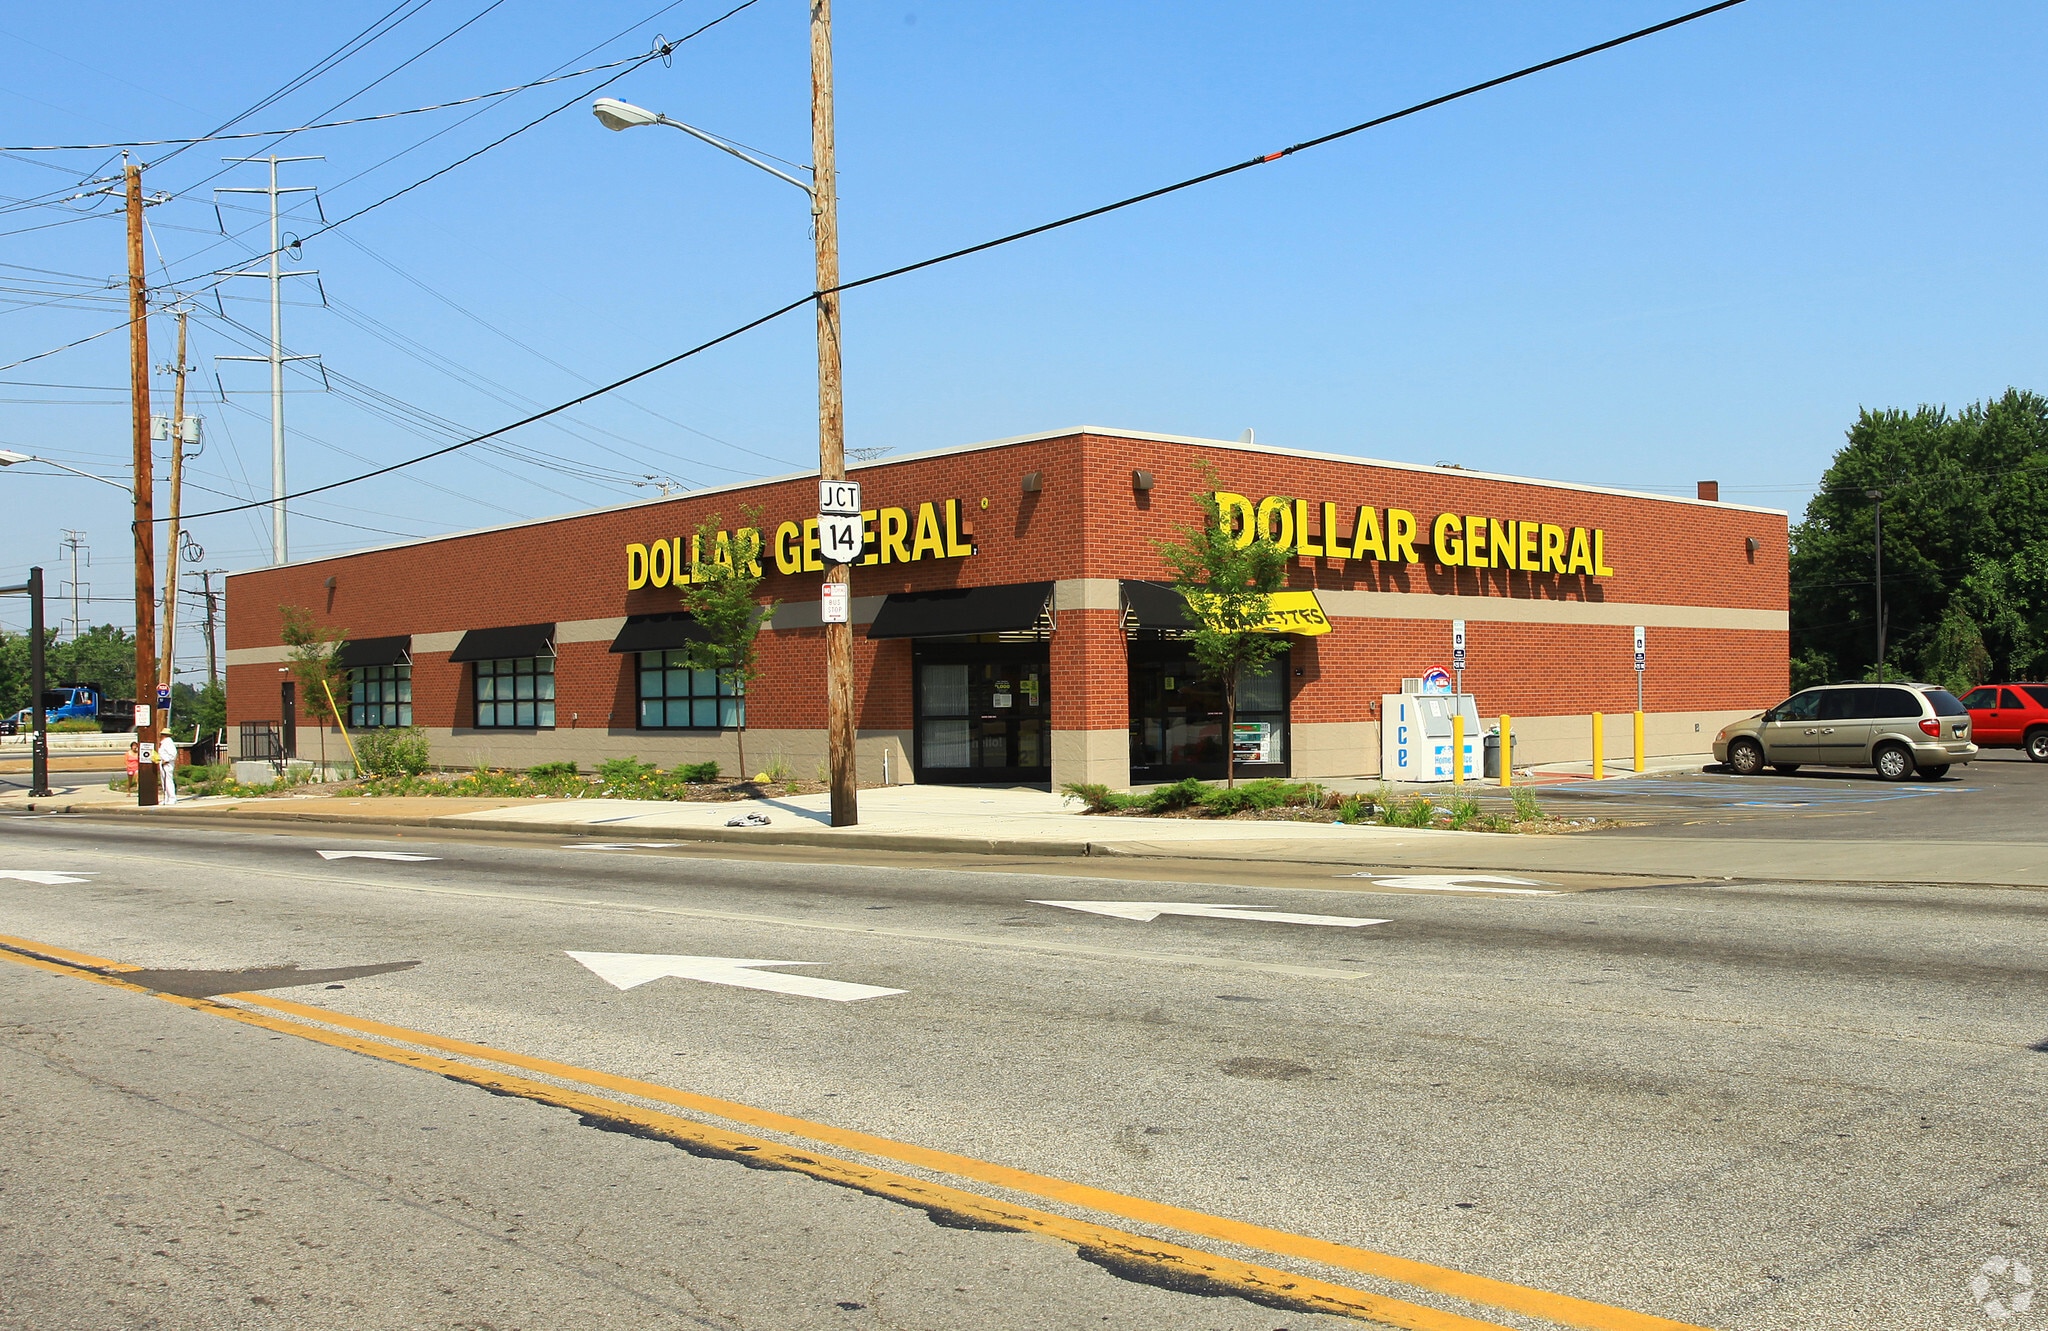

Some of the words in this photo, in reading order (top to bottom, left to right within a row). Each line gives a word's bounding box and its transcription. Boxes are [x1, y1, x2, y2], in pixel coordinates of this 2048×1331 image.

[823, 486, 856, 507] JCT
[626, 527, 763, 591] DOLLAR
[775, 498, 972, 575] GEERAL
[829, 524, 855, 551] 14
[1214, 491, 1419, 564] DOLLAR
[1434, 512, 1614, 577] GENERAL
